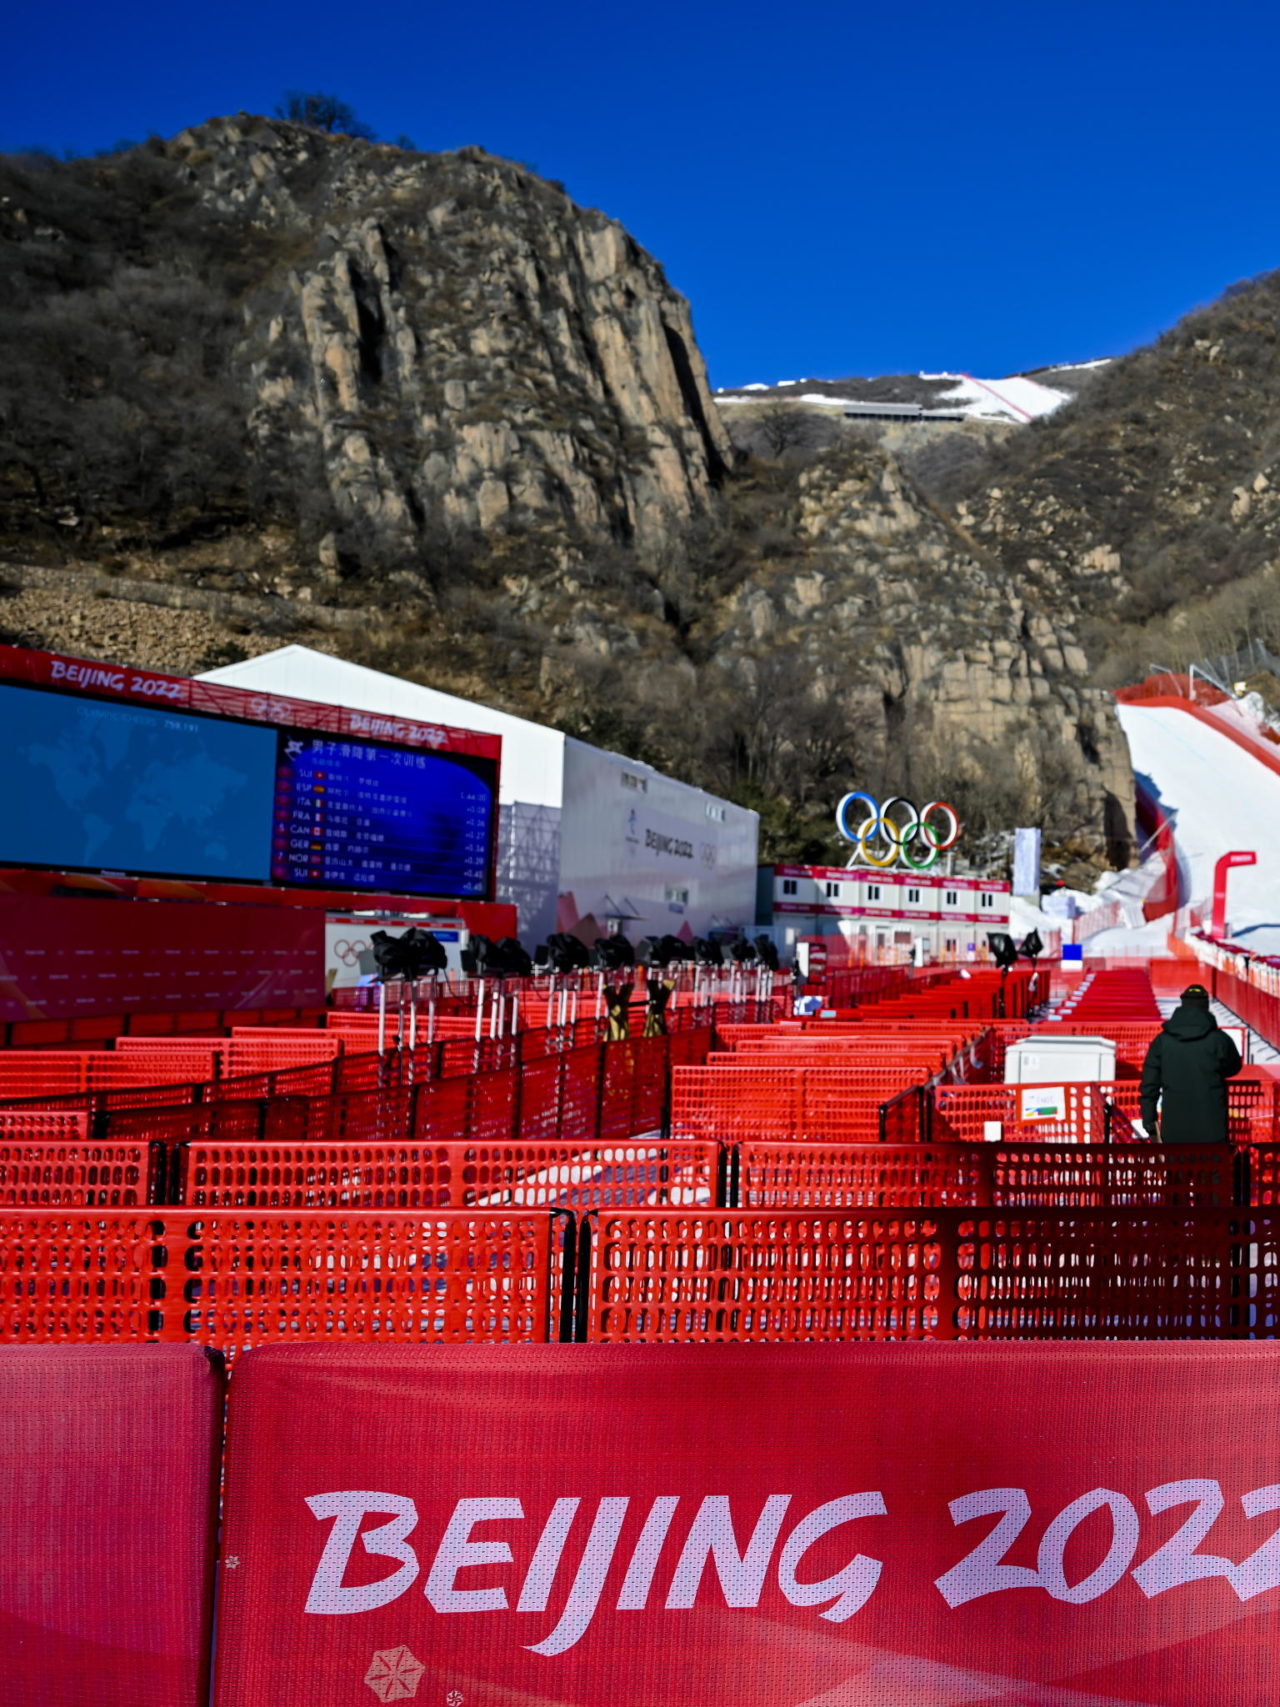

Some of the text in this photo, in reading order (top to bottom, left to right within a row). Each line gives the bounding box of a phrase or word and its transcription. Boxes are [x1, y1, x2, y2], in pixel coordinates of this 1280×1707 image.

[50, 660, 183, 698] BEIJING 2022
[350, 713, 449, 743] BEIJING 2022
[645, 828, 672, 856] BEIJING
[303, 1490, 888, 1657] BEIJING
